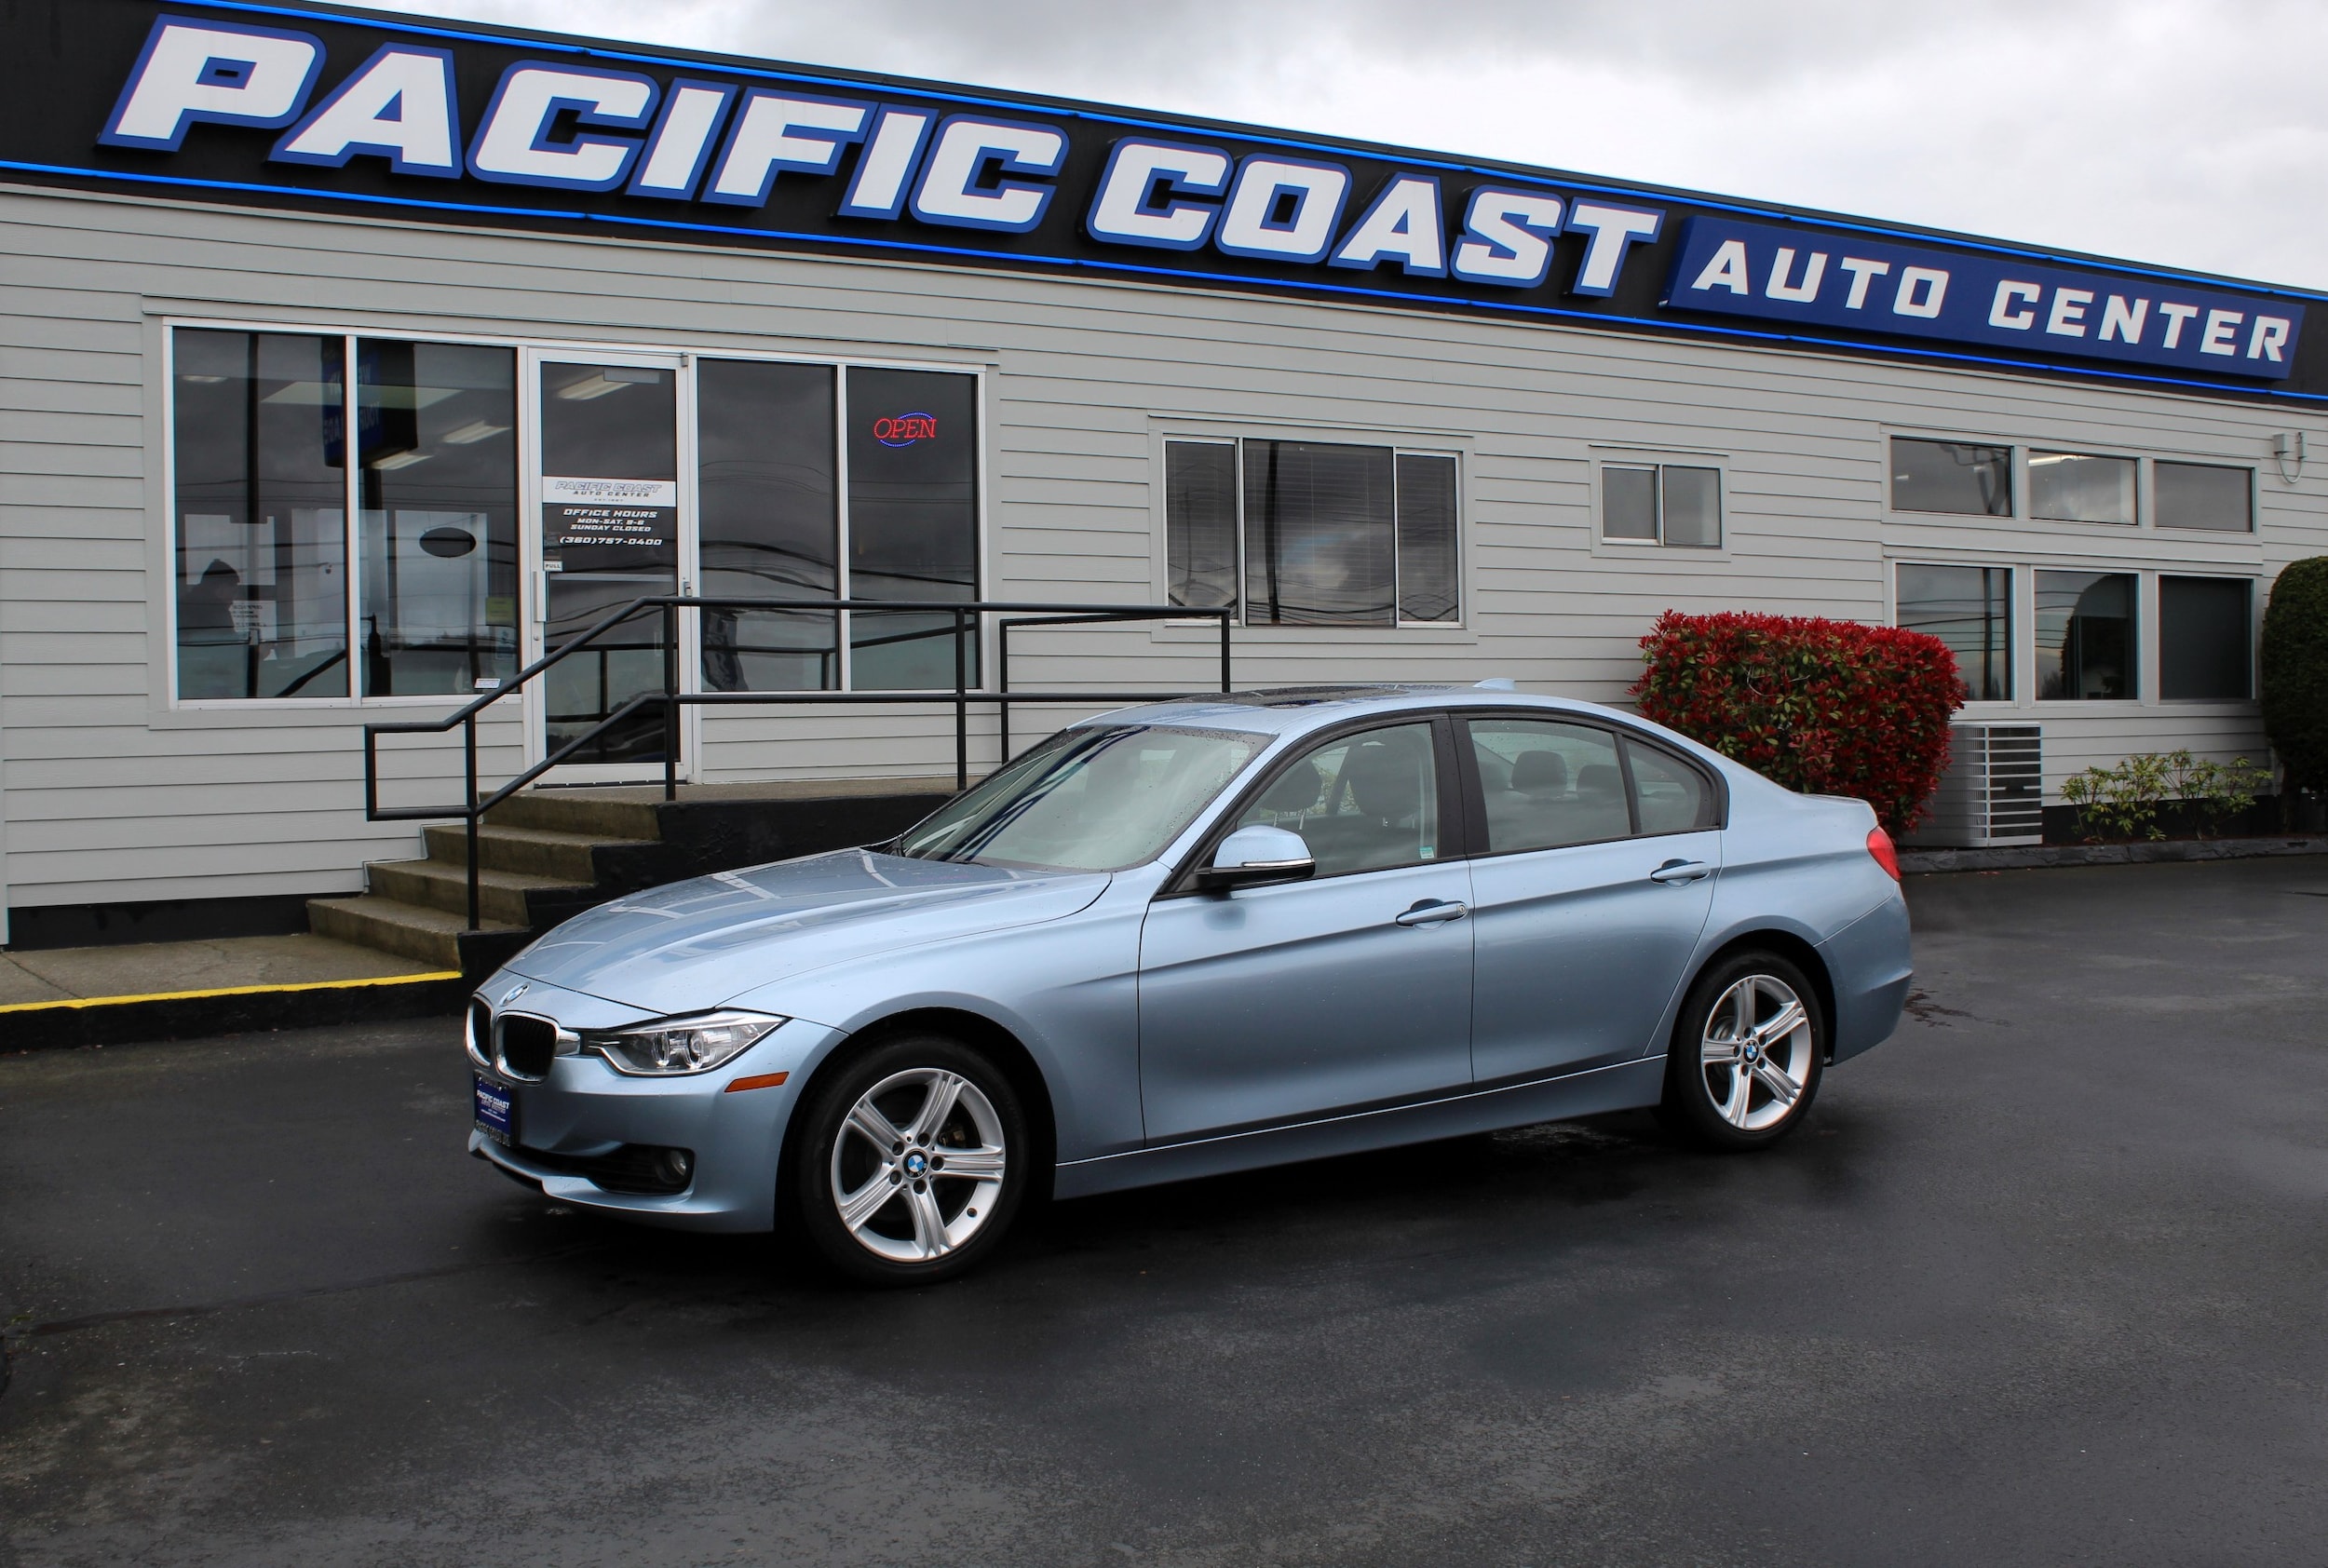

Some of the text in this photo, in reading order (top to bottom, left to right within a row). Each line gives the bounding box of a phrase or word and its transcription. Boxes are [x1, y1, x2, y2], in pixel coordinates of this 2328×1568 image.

[98, 13, 1668, 298] PACIFIC COAST
[1691, 240, 2291, 362] AUTO CENTER
[873, 417, 937, 439] OPEN
[556, 481, 662, 493] PACIFIC COAST
[563, 508, 658, 519] OFFICE HOURS
[494, 1098, 509, 1110] COAST
